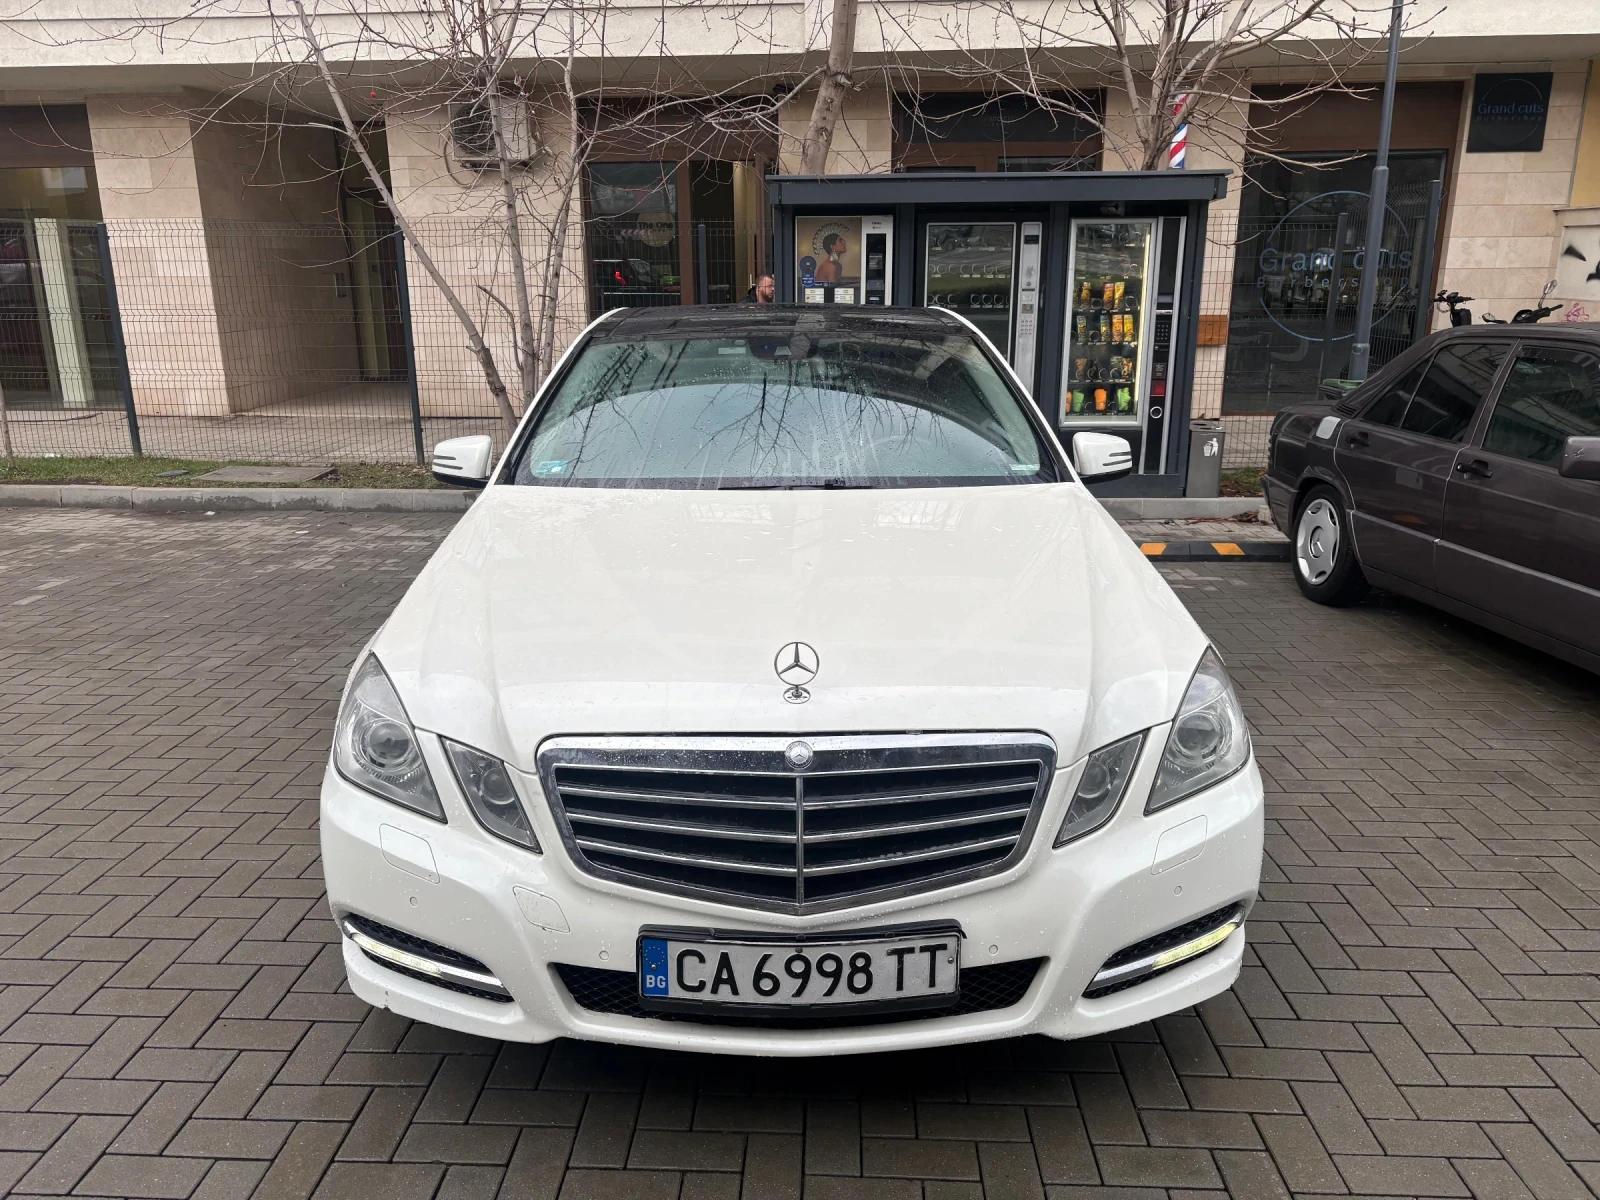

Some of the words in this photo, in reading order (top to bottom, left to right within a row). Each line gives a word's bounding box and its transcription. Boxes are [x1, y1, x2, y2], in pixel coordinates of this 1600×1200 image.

[1477, 102, 1515, 114] Grand
[1518, 103, 1544, 114] cuts
[1353, 249, 1413, 271] cts
[1256, 276, 1410, 289] Barbersop
[676, 948, 740, 996] CA
[752, 950, 873, 998] 6998
[886, 943, 948, 992] TT
[646, 974, 666, 989] BG
